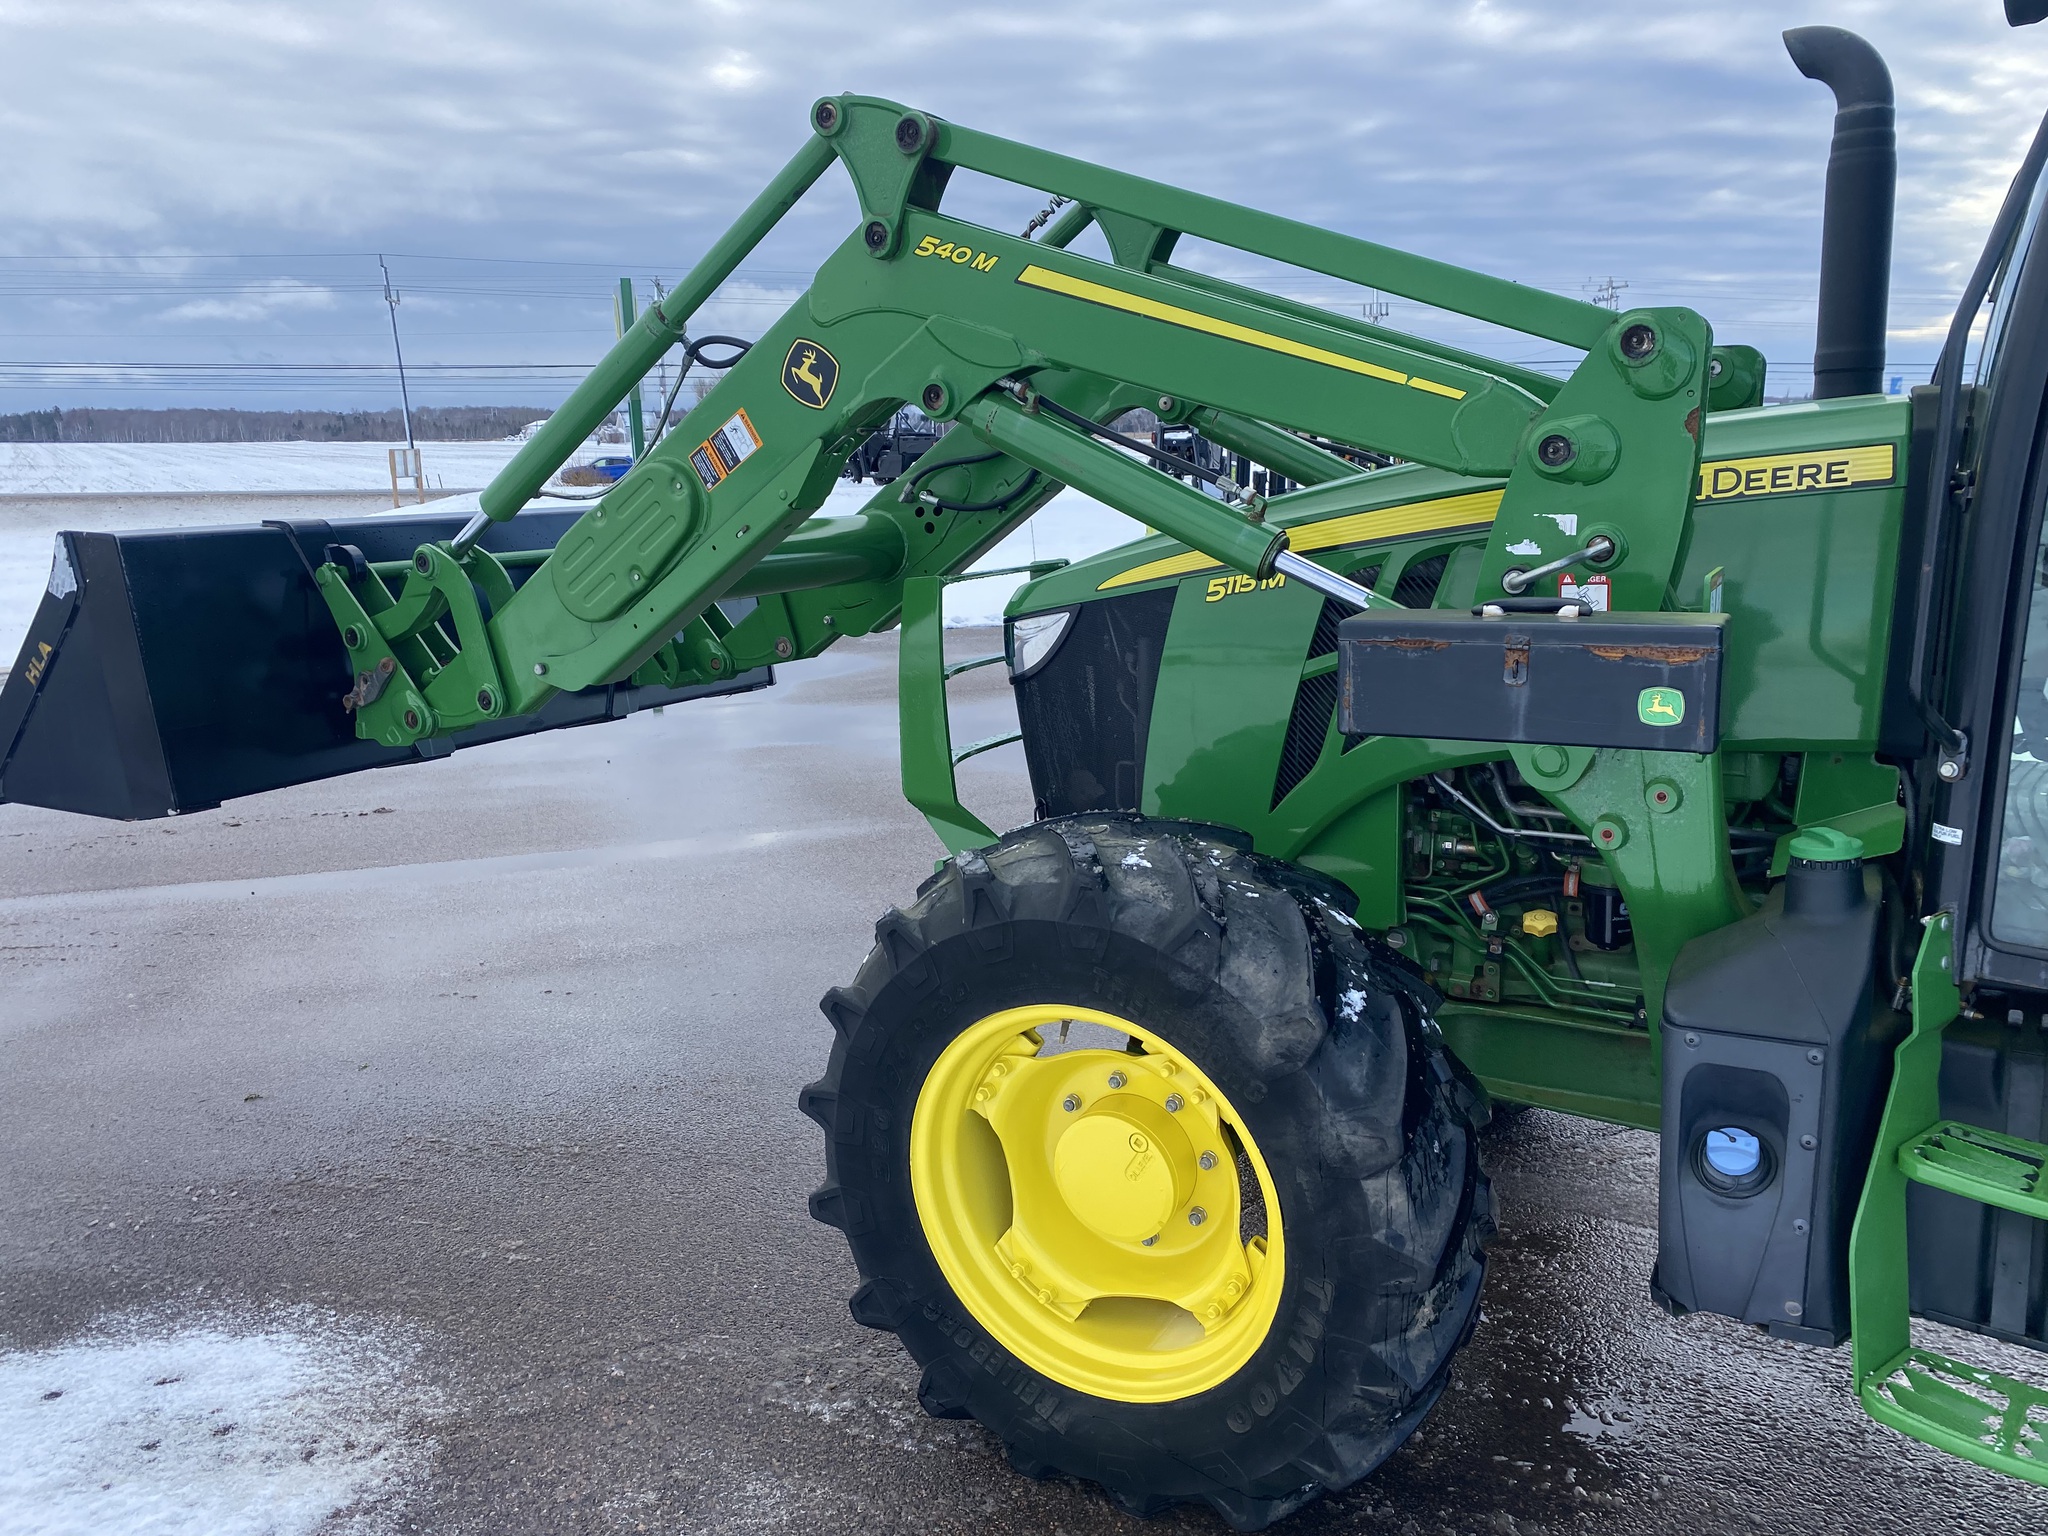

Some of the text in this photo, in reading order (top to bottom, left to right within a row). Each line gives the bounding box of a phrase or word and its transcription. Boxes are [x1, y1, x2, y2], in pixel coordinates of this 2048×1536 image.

[743, 418, 760, 444] WARNING
[708, 451, 724, 476] WARNING
[1711, 460, 1851, 497] DEERE
[25, 641, 53, 687] HLA
[922, 1301, 1073, 1436] TRELLEBORG
[1226, 1276, 1336, 1434] TM700
